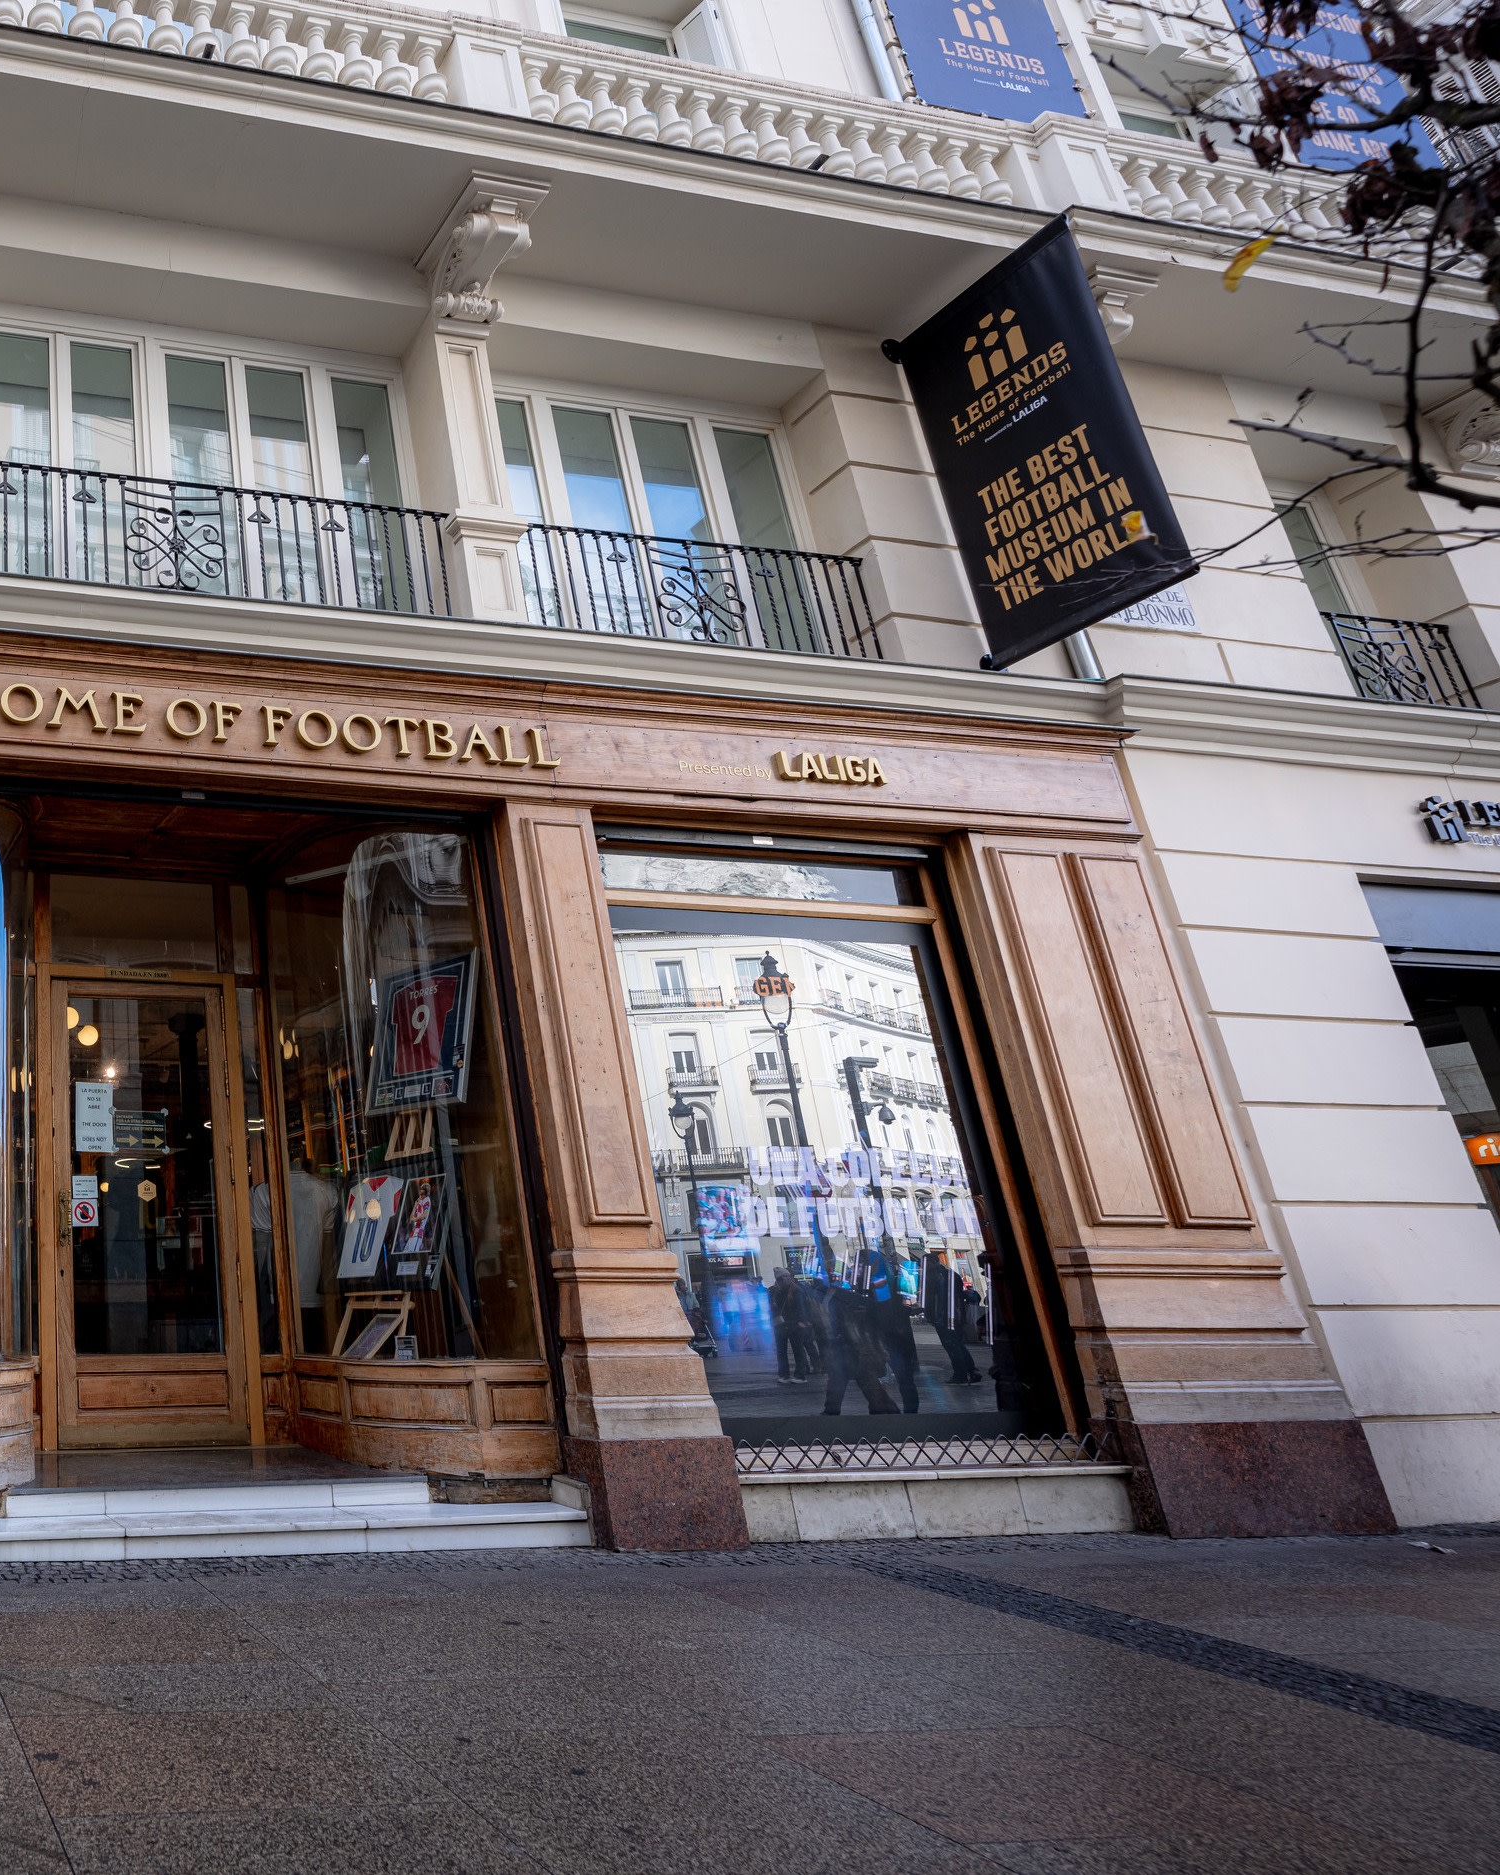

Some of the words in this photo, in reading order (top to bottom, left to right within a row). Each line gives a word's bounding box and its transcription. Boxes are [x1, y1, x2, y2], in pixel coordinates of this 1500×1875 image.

[938, 37, 1046, 75] LEGENDS
[945, 58, 963, 69] The
[966, 62, 992, 75] Home
[995, 69, 1005, 77] of
[1008, 72, 1050, 87] Football
[1000, 80, 1031, 93] LALIGA
[1360, 137, 1394, 162] ARE
[950, 341, 1067, 435] LEGENDS
[956, 430, 976, 446] The
[977, 409, 1005, 433] Home
[1008, 397, 1021, 411] of
[1023, 362, 1071, 401] Football
[1012, 395, 1048, 423] LALIGA
[977, 466, 1025, 515] THE
[1026, 423, 1091, 485] BEST
[984, 455, 1110, 547] FOOTBALL
[984, 497, 1096, 582] MUSEUM
[1098, 476, 1133, 517] IN
[994, 564, 1044, 611] THE
[1042, 515, 1136, 584] WORL
[1123, 602, 1196, 627] JERONIMO
[1166, 590, 1184, 603] DE
[165, 697, 243, 744] OF
[261, 704, 562, 770] FOOTBALL
[678, 760, 752, 778] Presented
[754, 765, 773, 781] by
[773, 750, 888, 787] LALIGA
[409, 985, 438, 1000] TORRES
[411, 1004, 431, 1045] 9
[351, 1217, 379, 1264] 10
